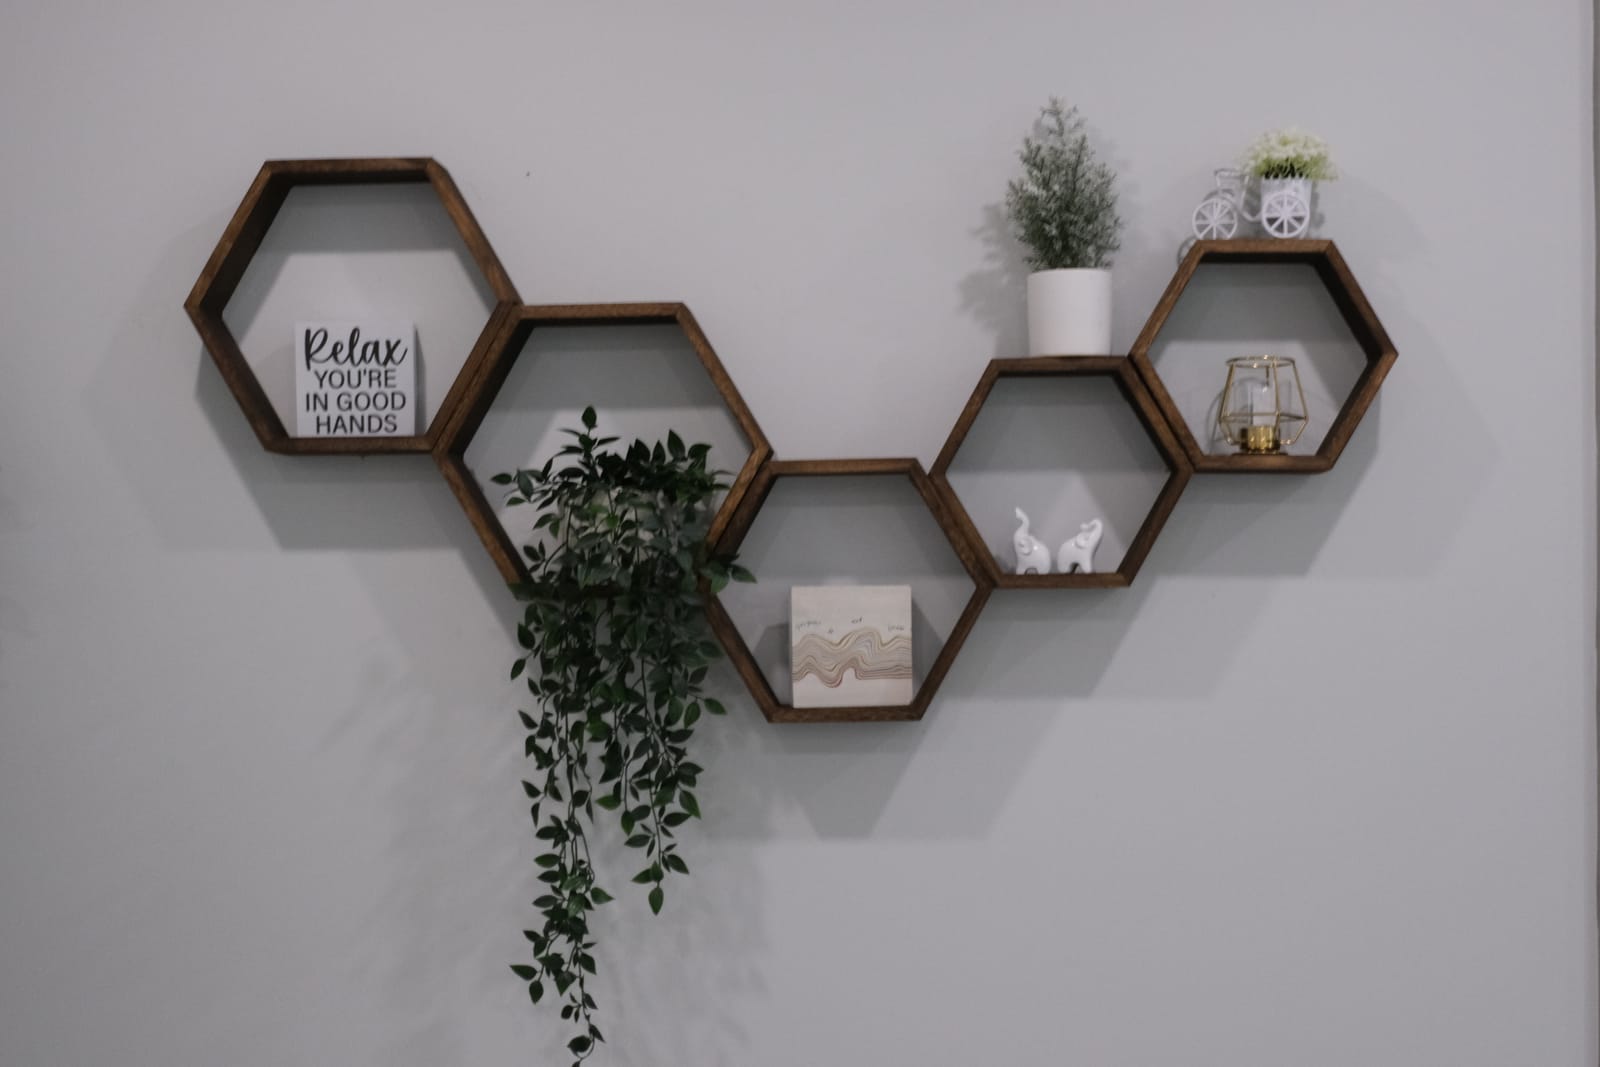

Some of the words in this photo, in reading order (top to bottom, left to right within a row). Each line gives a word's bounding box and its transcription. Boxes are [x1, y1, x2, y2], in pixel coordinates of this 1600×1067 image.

[304, 326, 408, 371] Relax
[314, 368, 397, 389] YOU'RE
[306, 391, 329, 412] IN
[336, 391, 407, 412] GOOD
[316, 413, 398, 434] HANDS
